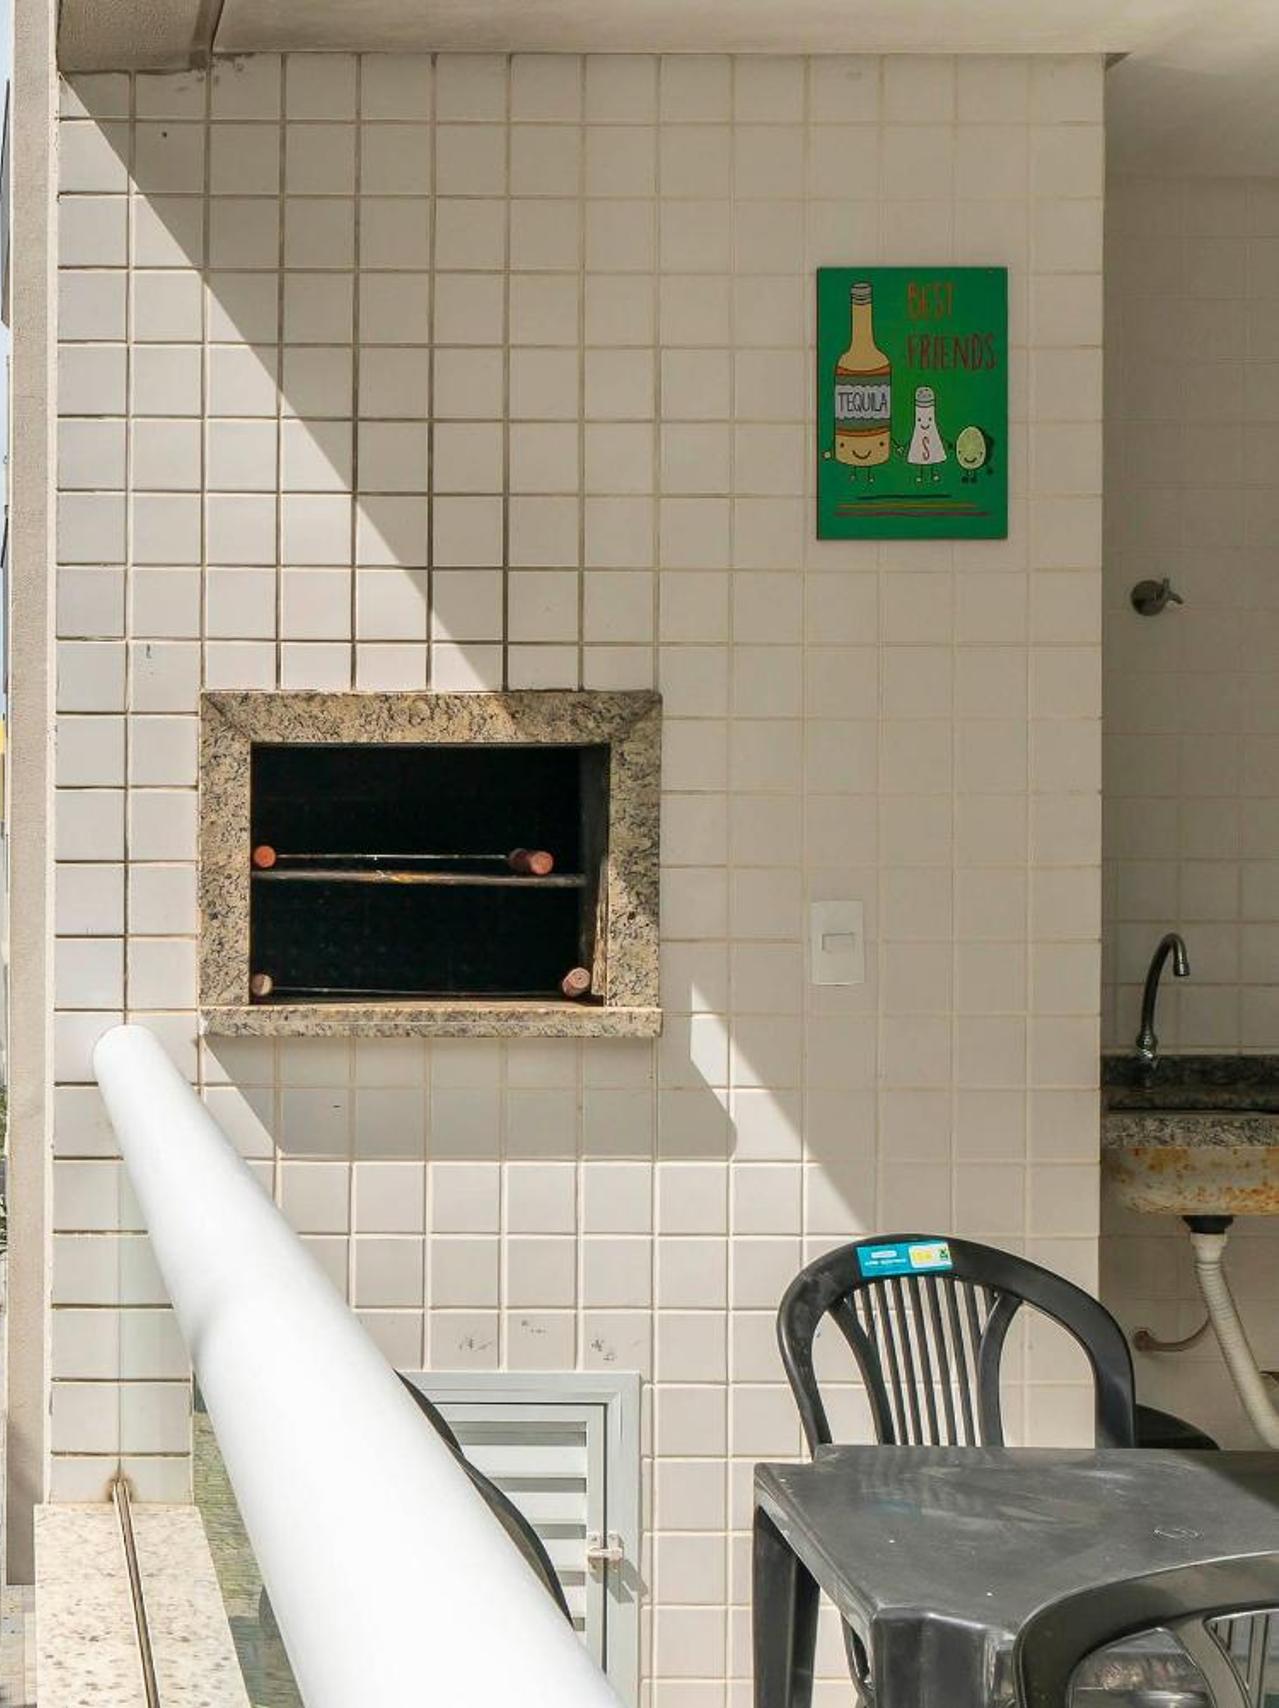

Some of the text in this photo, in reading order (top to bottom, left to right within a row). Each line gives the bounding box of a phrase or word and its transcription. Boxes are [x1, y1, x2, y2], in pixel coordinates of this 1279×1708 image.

[907, 282, 954, 319] BEST
[906, 333, 998, 370] FRIENDS
[838, 392, 888, 413] TEQUILA
[922, 436, 931, 461] S
